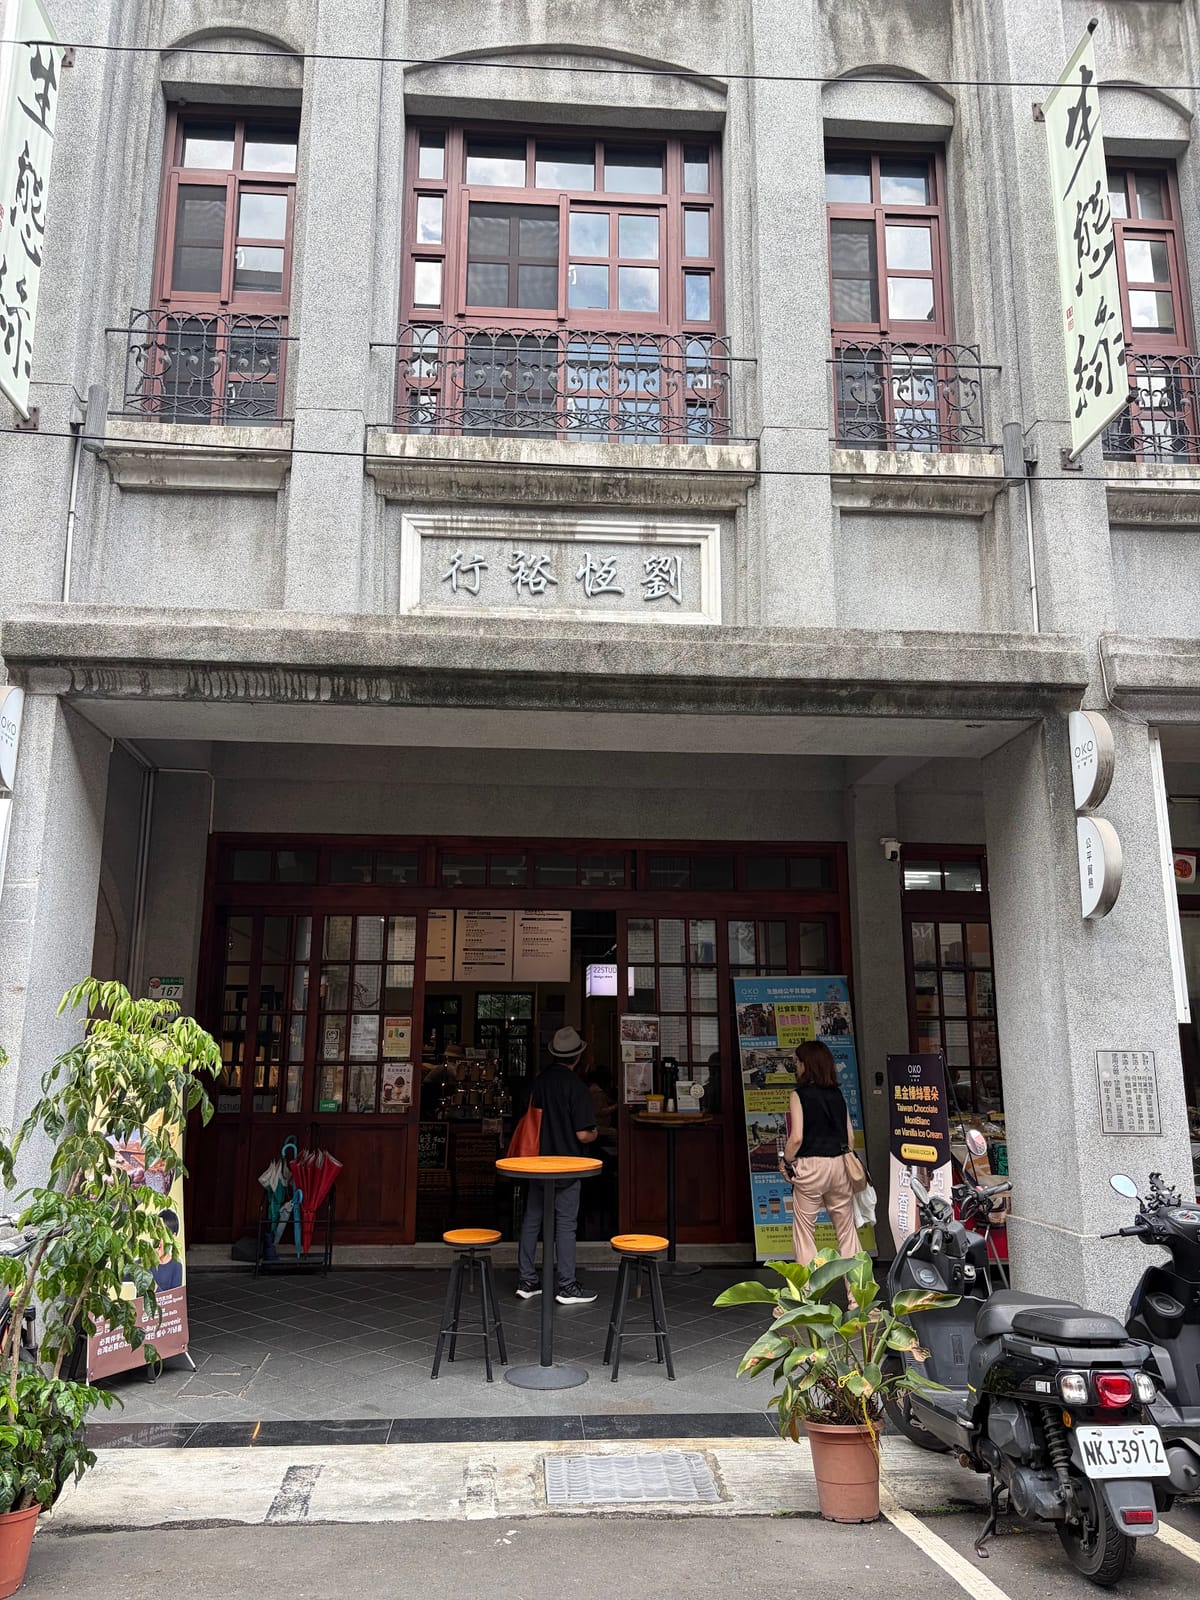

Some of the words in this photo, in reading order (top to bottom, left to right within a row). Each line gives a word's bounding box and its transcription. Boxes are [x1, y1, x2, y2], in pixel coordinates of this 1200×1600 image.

[1074, 740, 1094, 758] OKO
[161, 986, 180, 997] 167
[907, 1064, 921, 1074] OKO
[896, 1103, 913, 1112] Taiwan
[913, 1104, 938, 1114] Chocolate
[904, 1115, 930, 1125] MontBlanc
[894, 1128, 901, 1136] on
[901, 1128, 917, 1137] Vanilla
[918, 1129, 926, 1137] Ice
[926, 1130, 943, 1139] Cream
